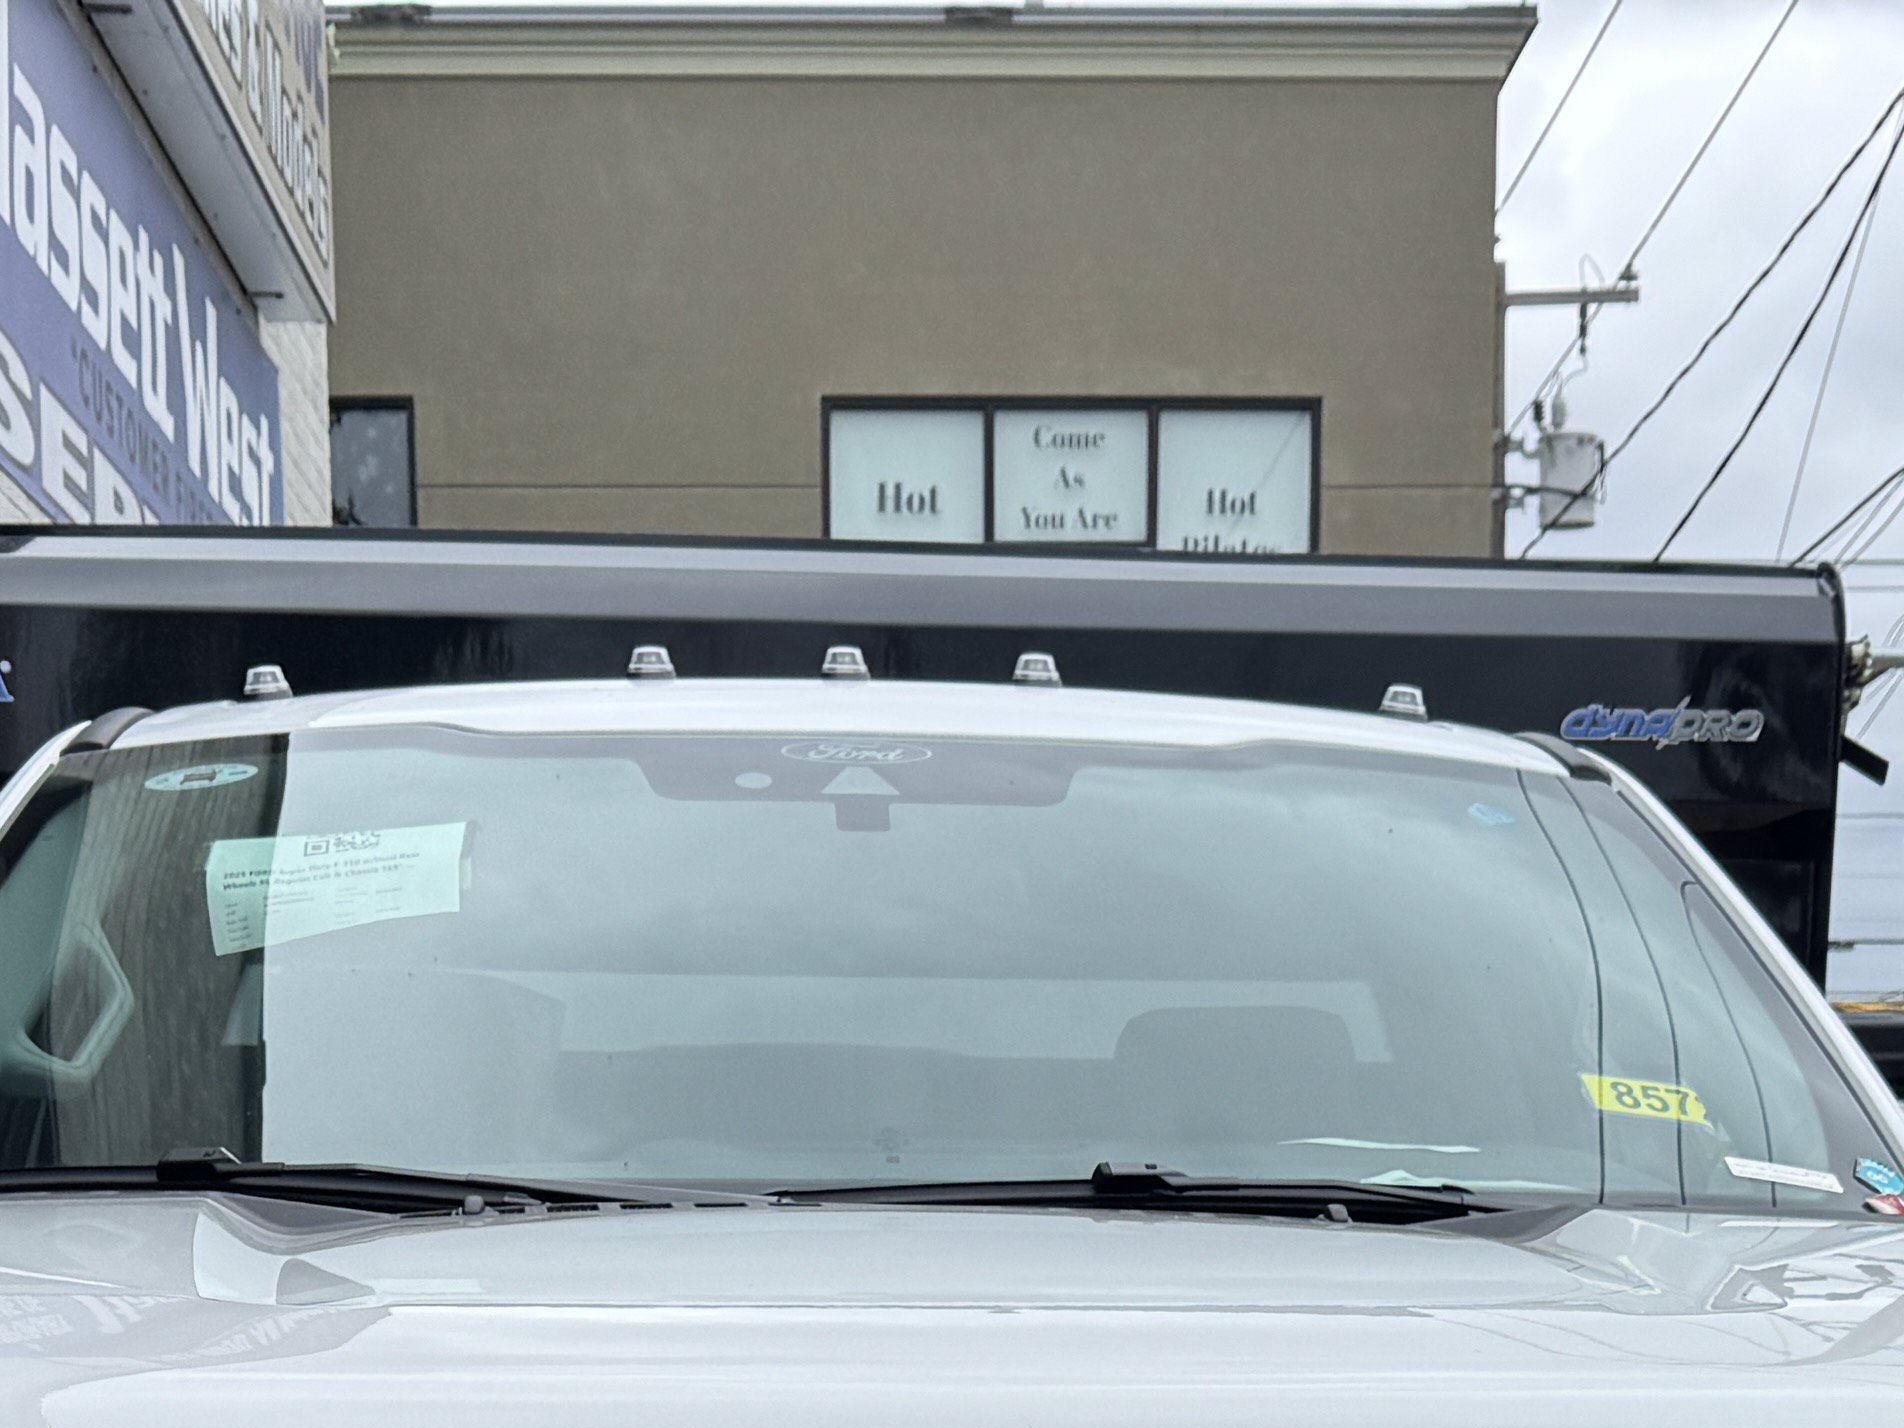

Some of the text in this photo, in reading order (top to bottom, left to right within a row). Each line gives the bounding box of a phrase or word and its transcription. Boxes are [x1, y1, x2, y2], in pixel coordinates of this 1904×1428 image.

[172, 242, 275, 527] West
[1033, 424, 1106, 449] Come
[1054, 465, 1086, 489] As
[876, 480, 939, 515] Hot
[1204, 487, 1258, 516] Hot
[1020, 506, 1119, 530] You Are
[1609, 1081, 1690, 1117] 857
